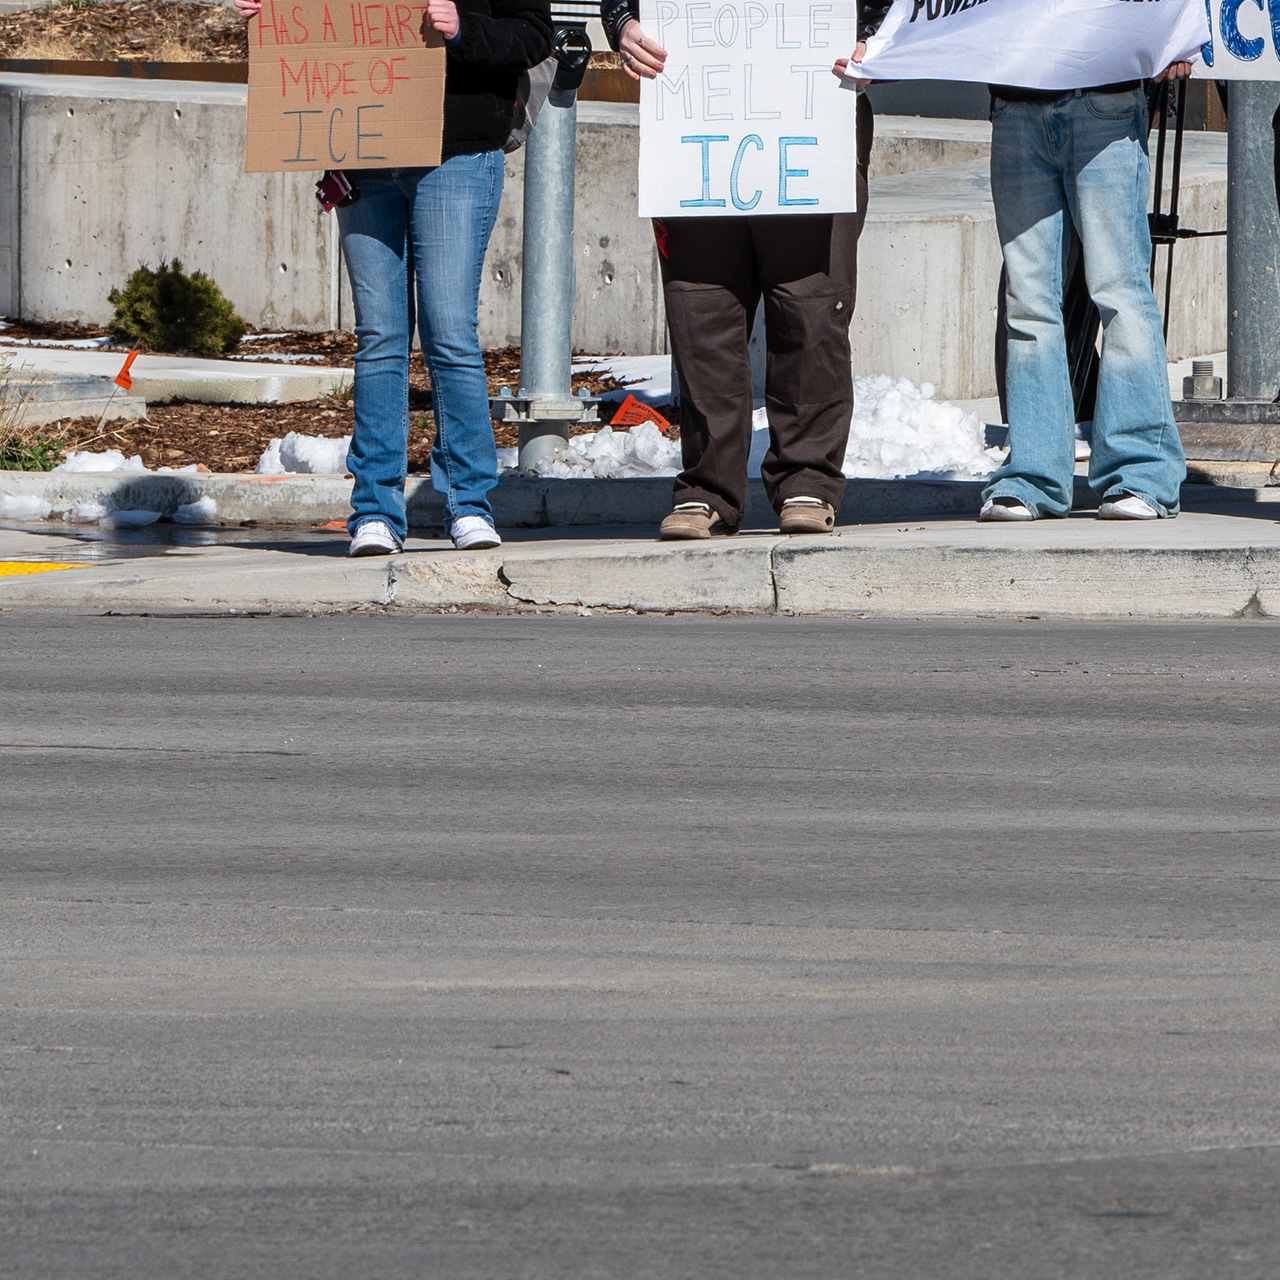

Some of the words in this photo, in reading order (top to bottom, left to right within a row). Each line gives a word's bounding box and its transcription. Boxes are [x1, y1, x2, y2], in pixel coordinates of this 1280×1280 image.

[257, 0, 310, 48] HAS
[322, 4, 337, 42] A
[350, 2, 428, 48] HEART
[655, 0, 832, 50] PEOPLE
[279, 57, 359, 104] MADE
[368, 57, 410, 95] OF
[655, 63, 834, 121] MELT
[280, 104, 388, 164] ICE
[680, 134, 819, 211] ICE
[631, 402, 663, 424] CAUTION
